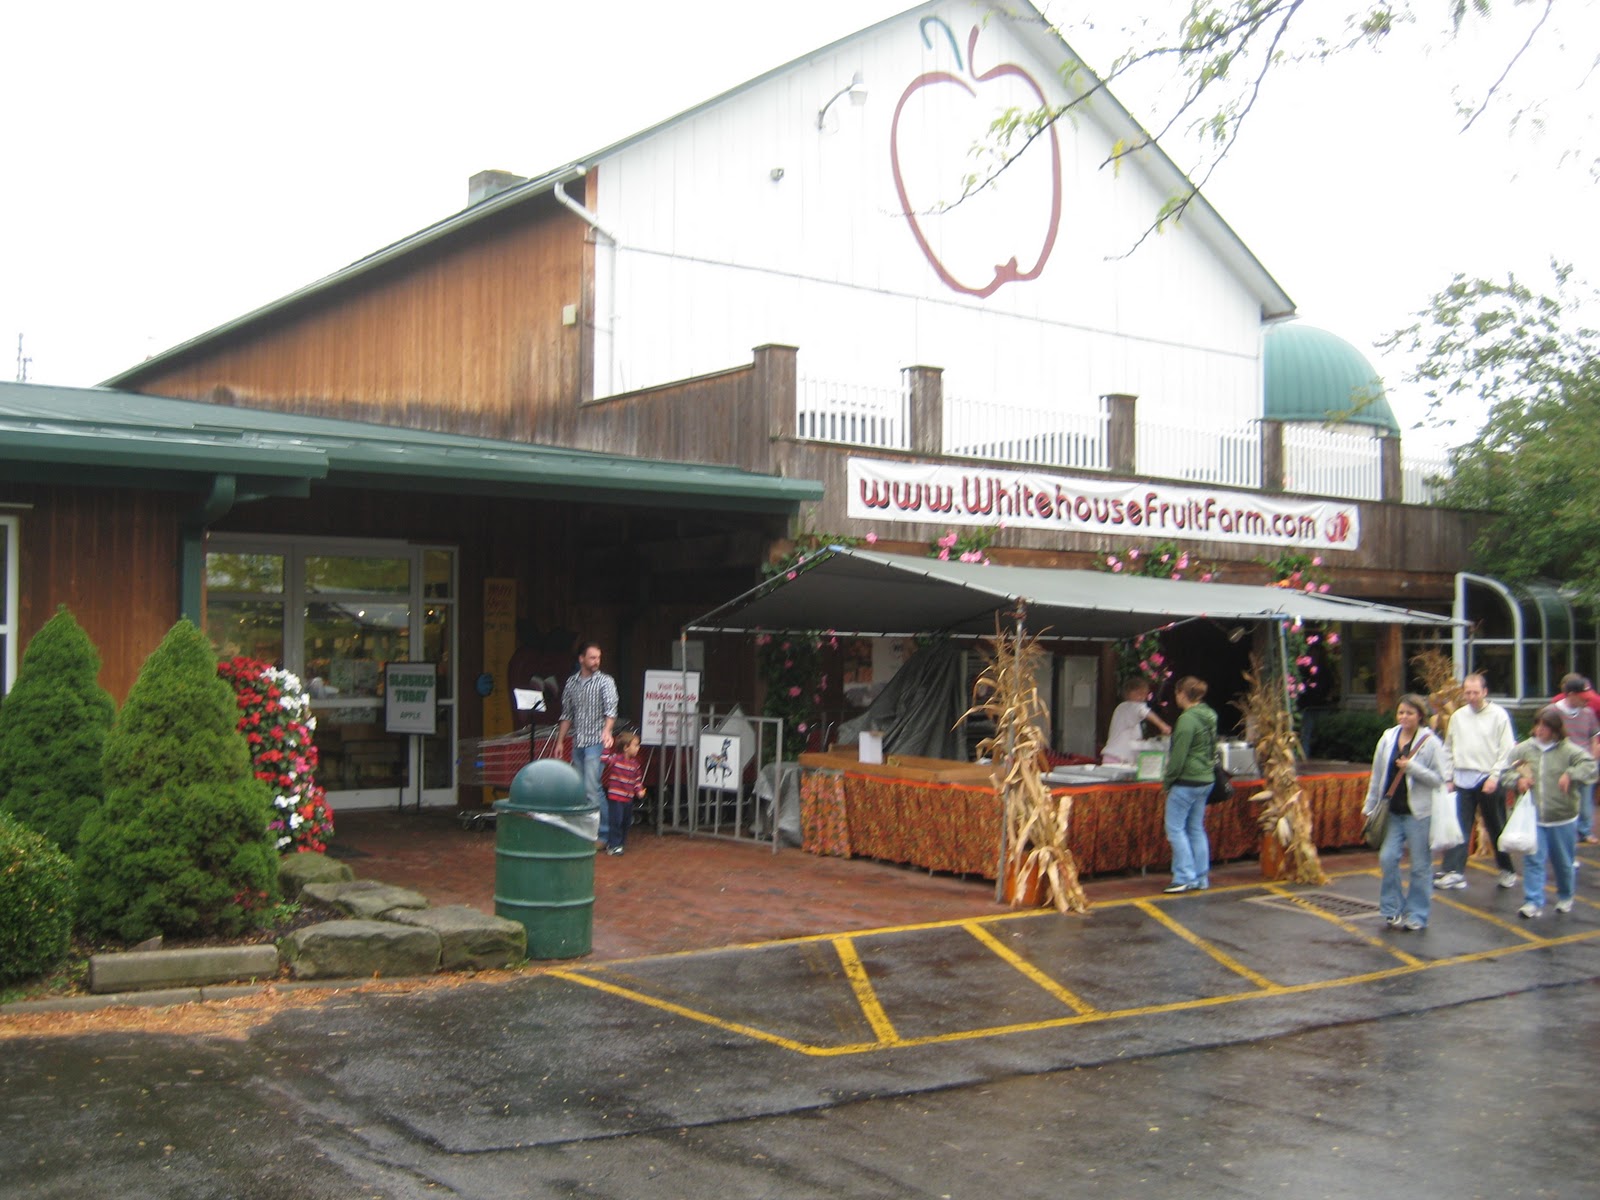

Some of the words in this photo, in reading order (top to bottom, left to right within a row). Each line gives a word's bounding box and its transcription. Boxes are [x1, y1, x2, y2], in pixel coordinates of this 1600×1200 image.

[859, 475, 1316, 540] www.WhitehouseFruitFarm.com
[394, 689, 428, 703] TODAY
[399, 711, 422, 720] APPLE
